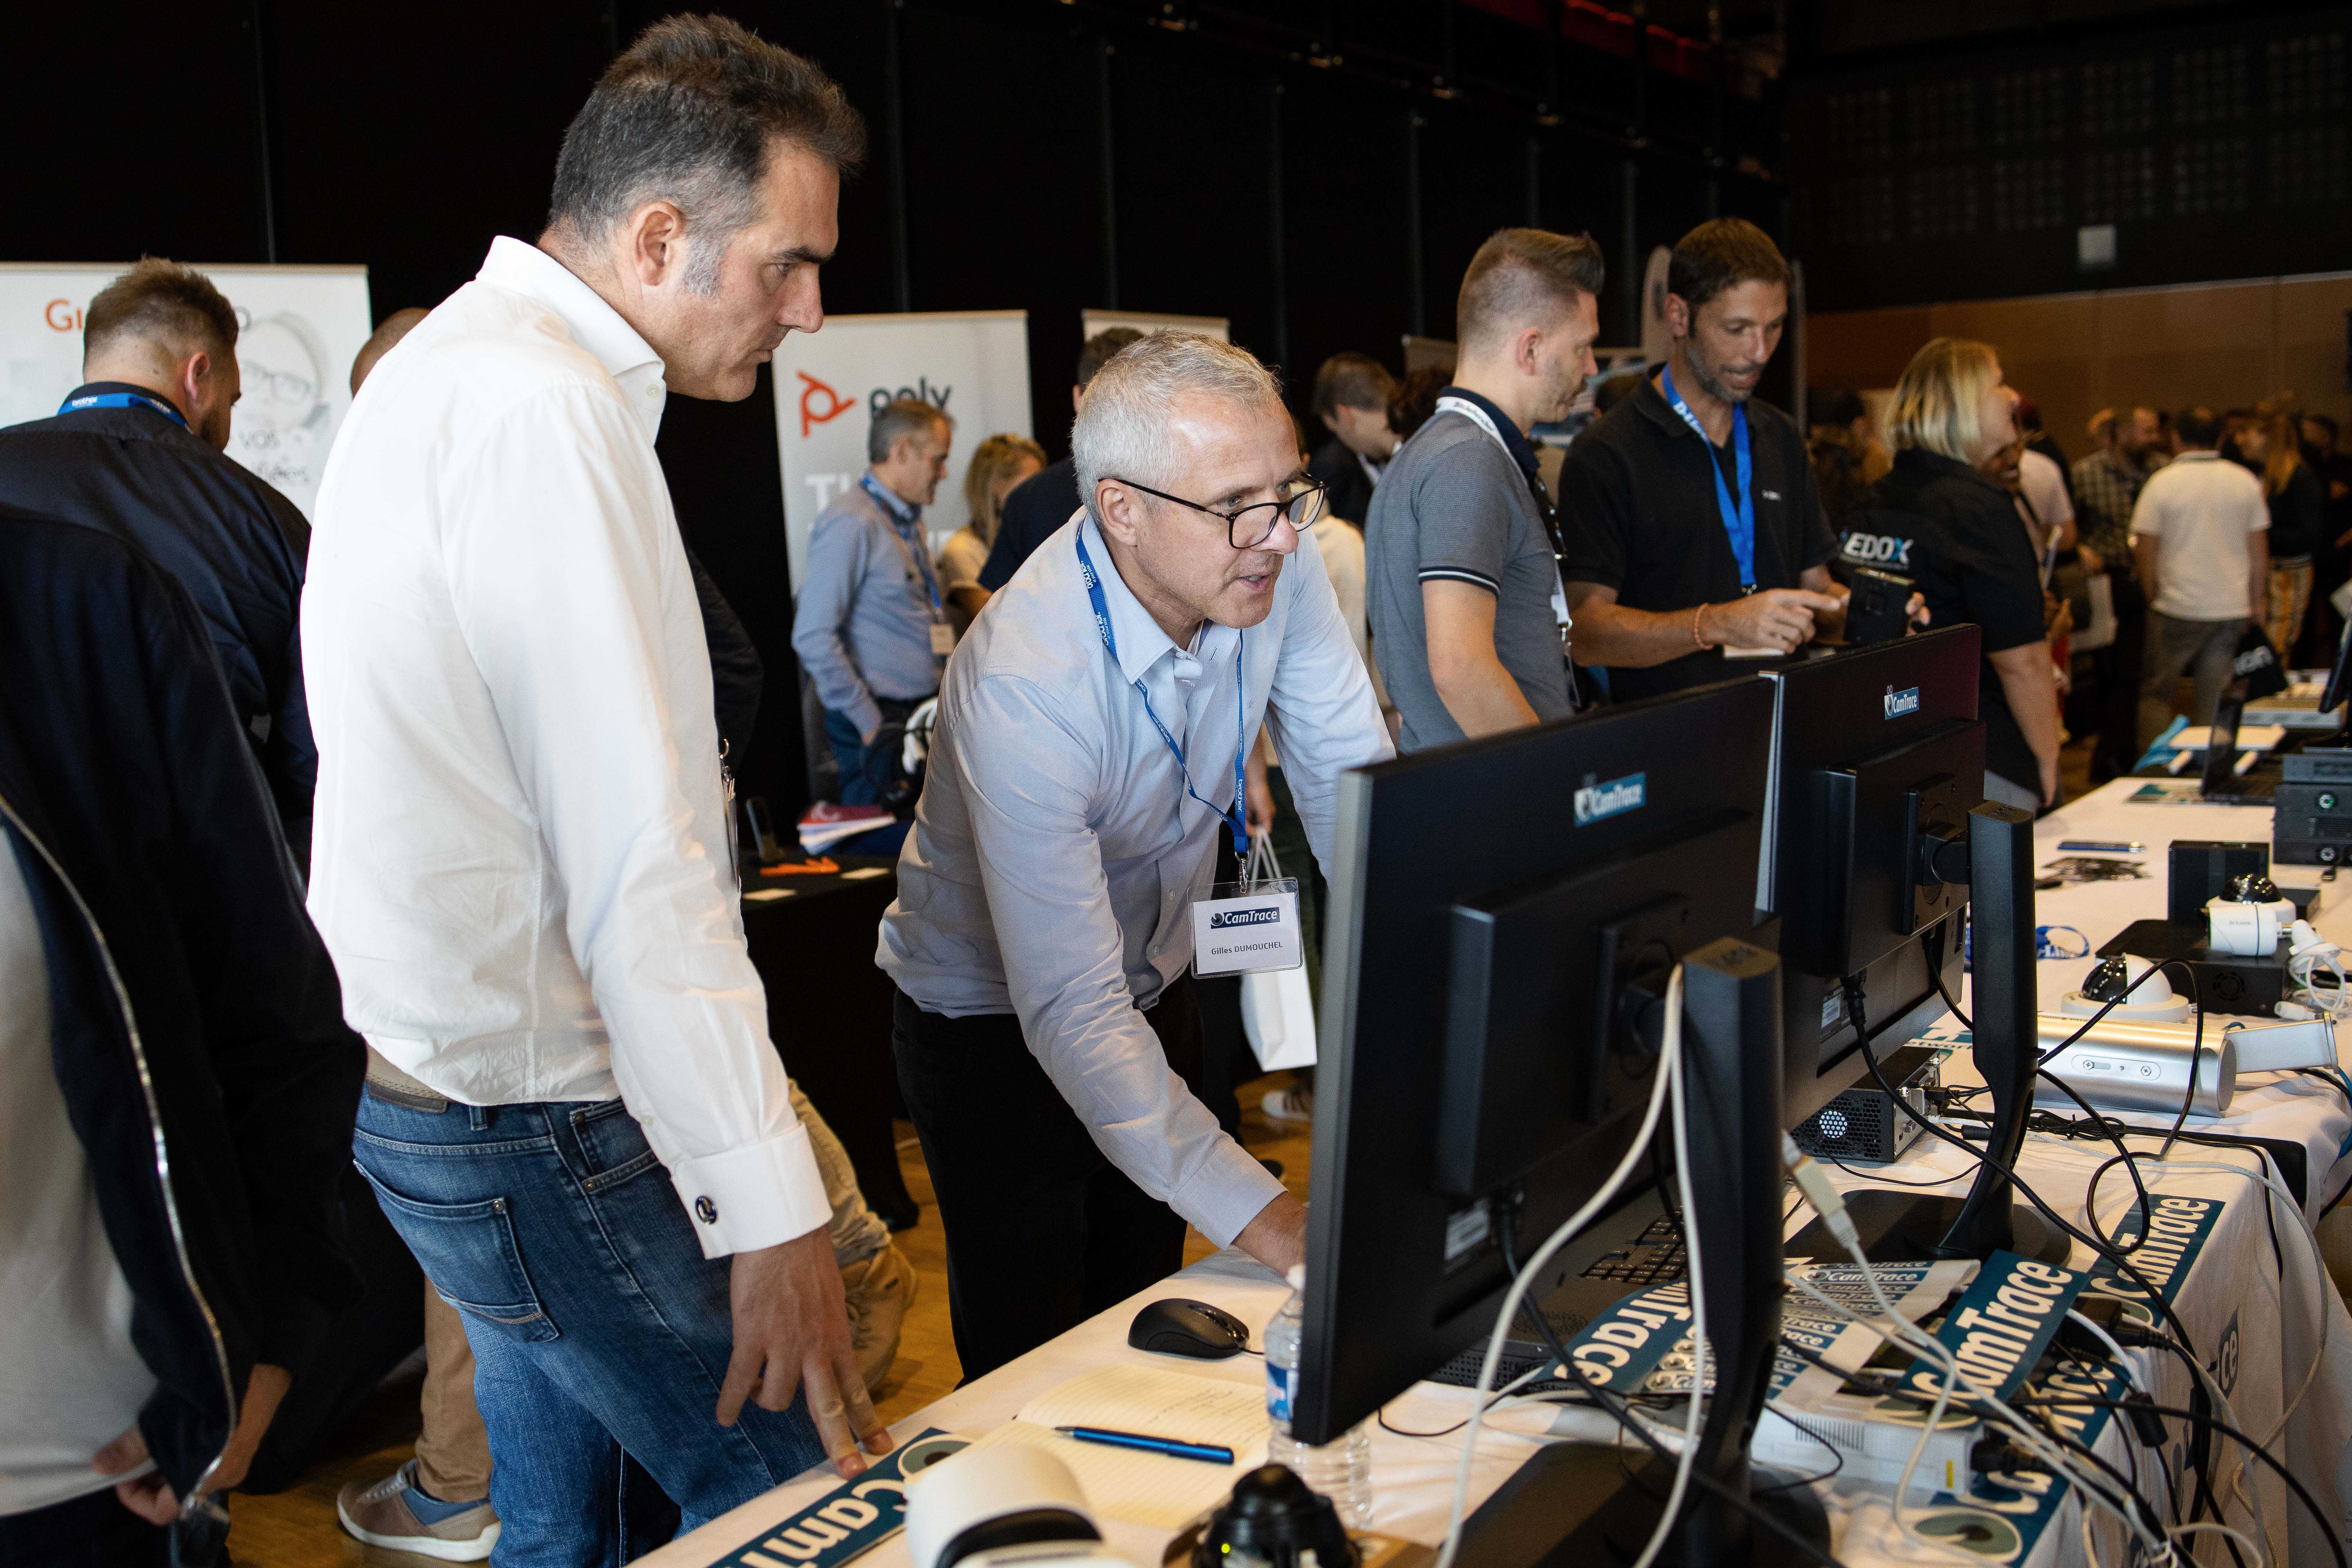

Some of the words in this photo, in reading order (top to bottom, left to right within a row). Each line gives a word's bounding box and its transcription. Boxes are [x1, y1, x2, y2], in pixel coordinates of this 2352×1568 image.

[1894, 694, 1917, 713] CamTrace
[1225, 911, 1278, 924] CamTrace
[1234, 941, 1283, 952] DUMOUCHEL
[2091, 1198, 2210, 1299] CamTrace
[1912, 1261, 2073, 1401] CamTrace
